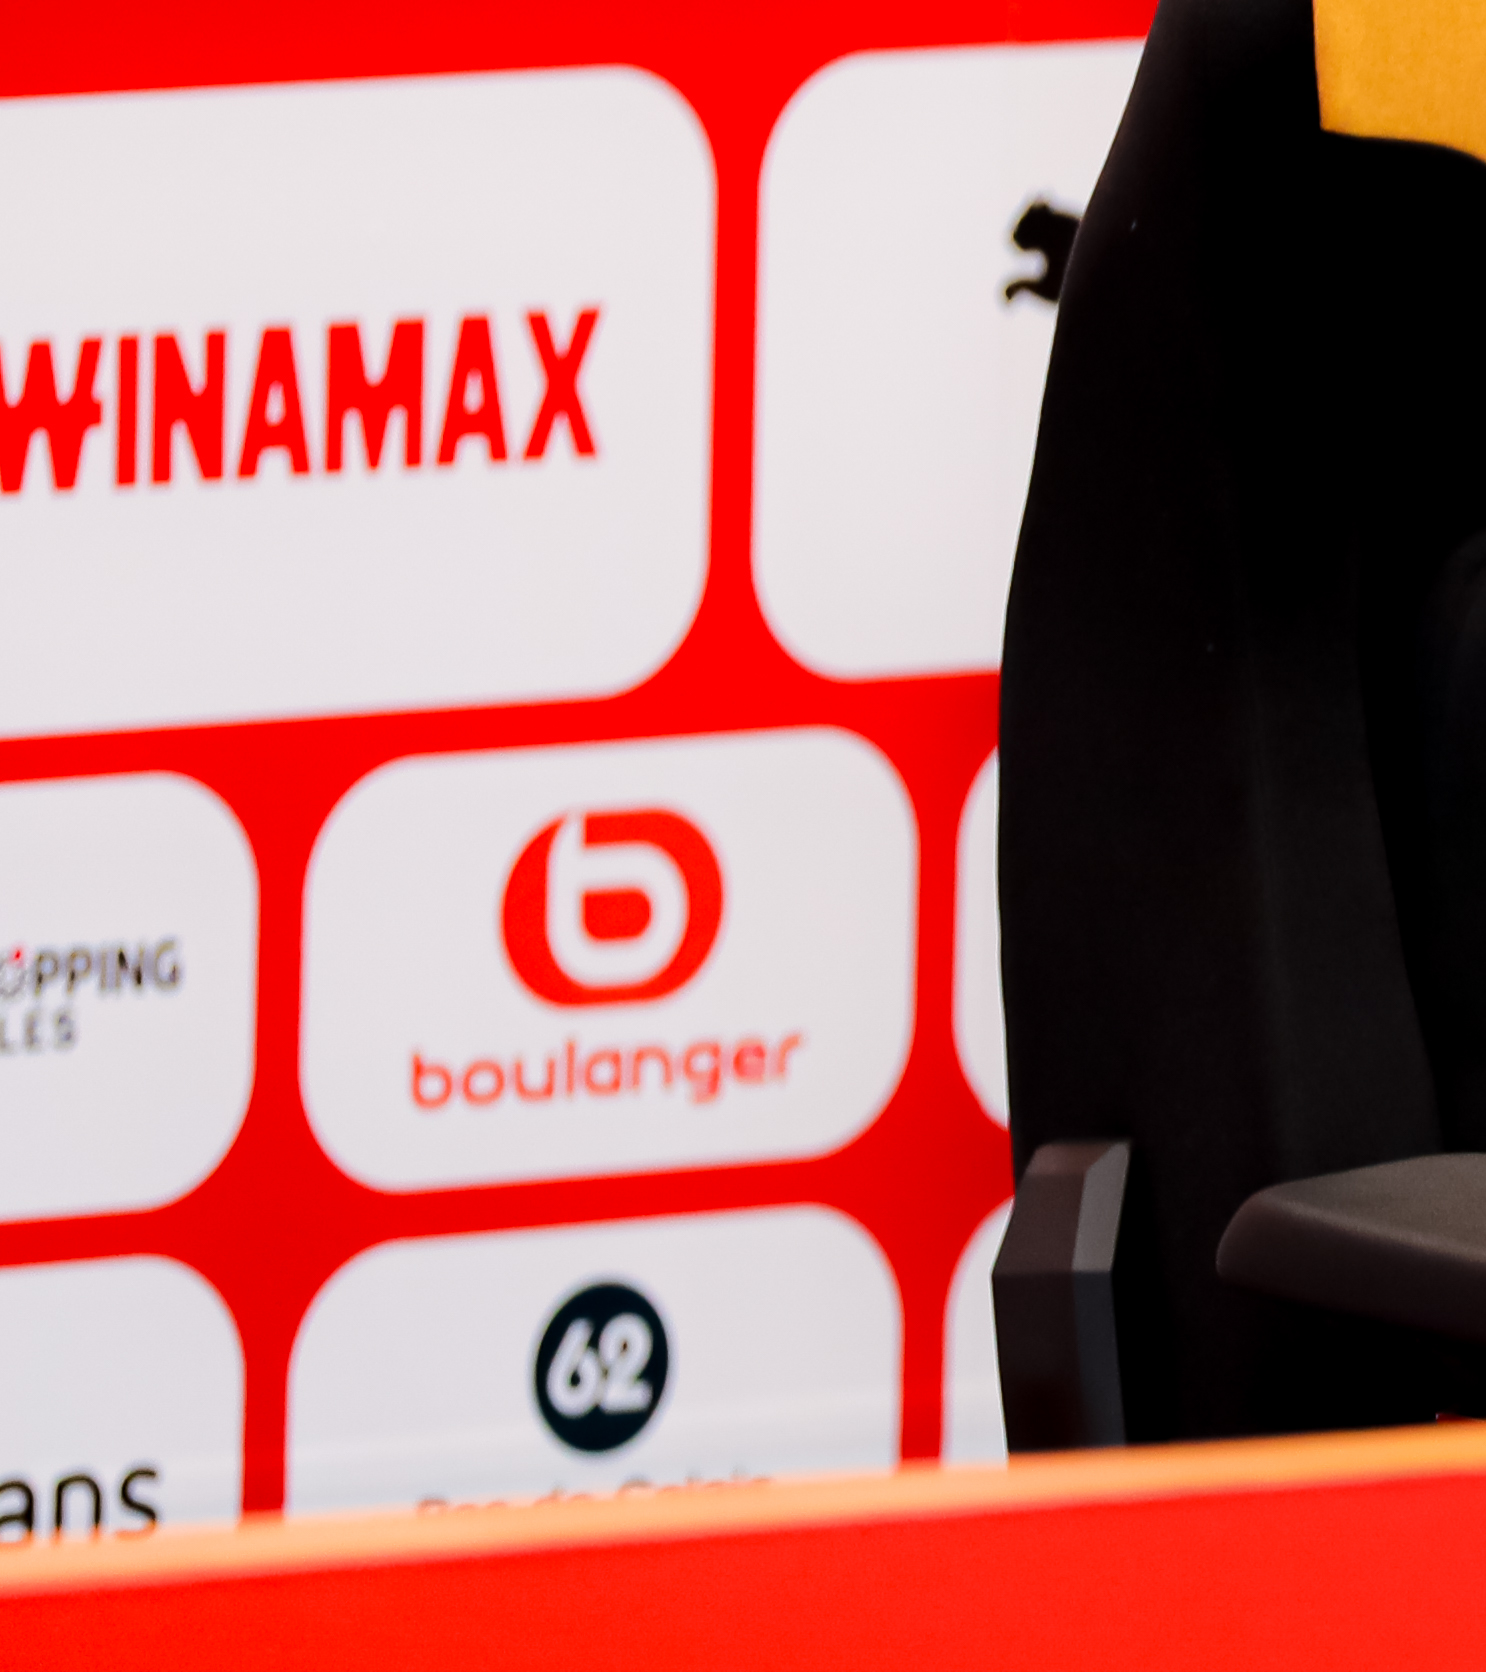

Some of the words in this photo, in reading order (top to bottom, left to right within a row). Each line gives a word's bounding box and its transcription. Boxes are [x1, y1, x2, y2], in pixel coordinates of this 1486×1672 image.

[0, 307, 600, 496] WINAMAX
[410, 1033, 803, 1111] boulanger
[545, 1311, 654, 1418] 62
